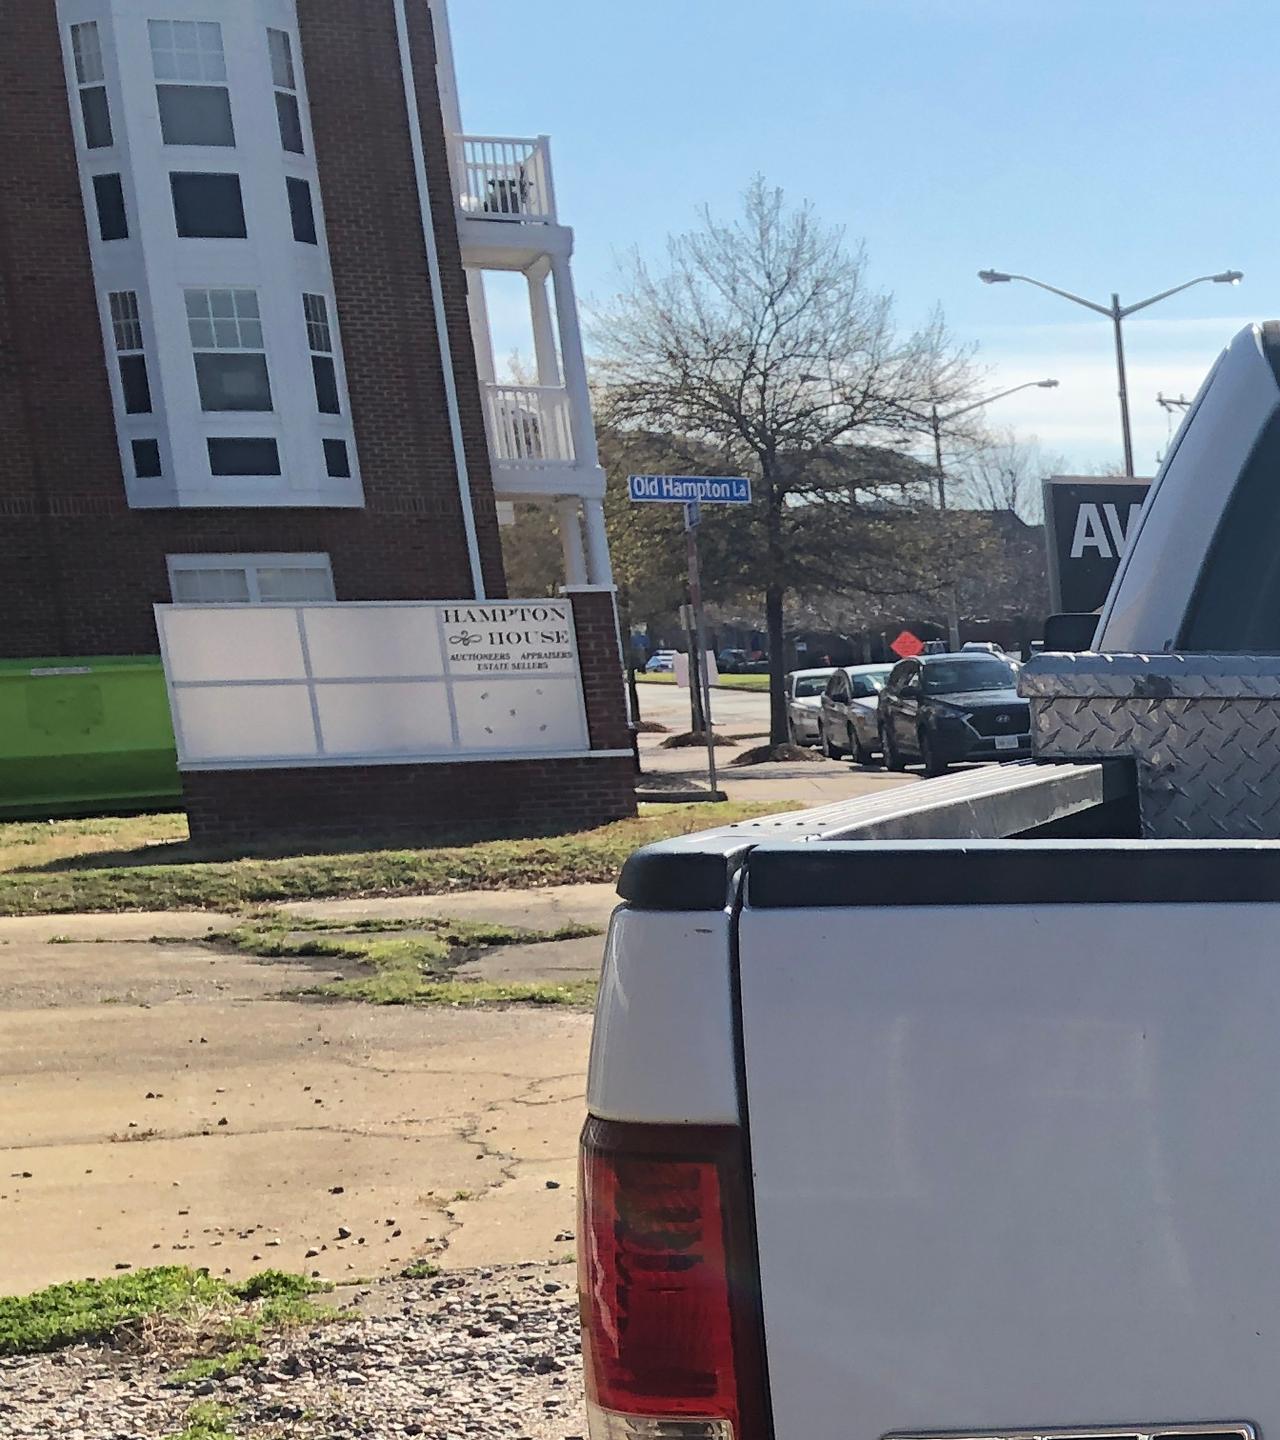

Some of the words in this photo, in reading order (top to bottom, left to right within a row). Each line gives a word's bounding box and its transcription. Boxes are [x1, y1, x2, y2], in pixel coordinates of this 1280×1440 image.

[633, 477, 659, 496] Old
[662, 477, 731, 501] Hampton
[732, 480, 747, 497] La
[443, 607, 566, 623] HAMPTON
[488, 630, 569, 645] HOUSE
[450, 652, 511, 661] AUCTIONEERS
[520, 651, 573, 660] APPRAISERS
[477, 662, 509, 671] ESTATE
[511, 661, 549, 670] SELLERS
